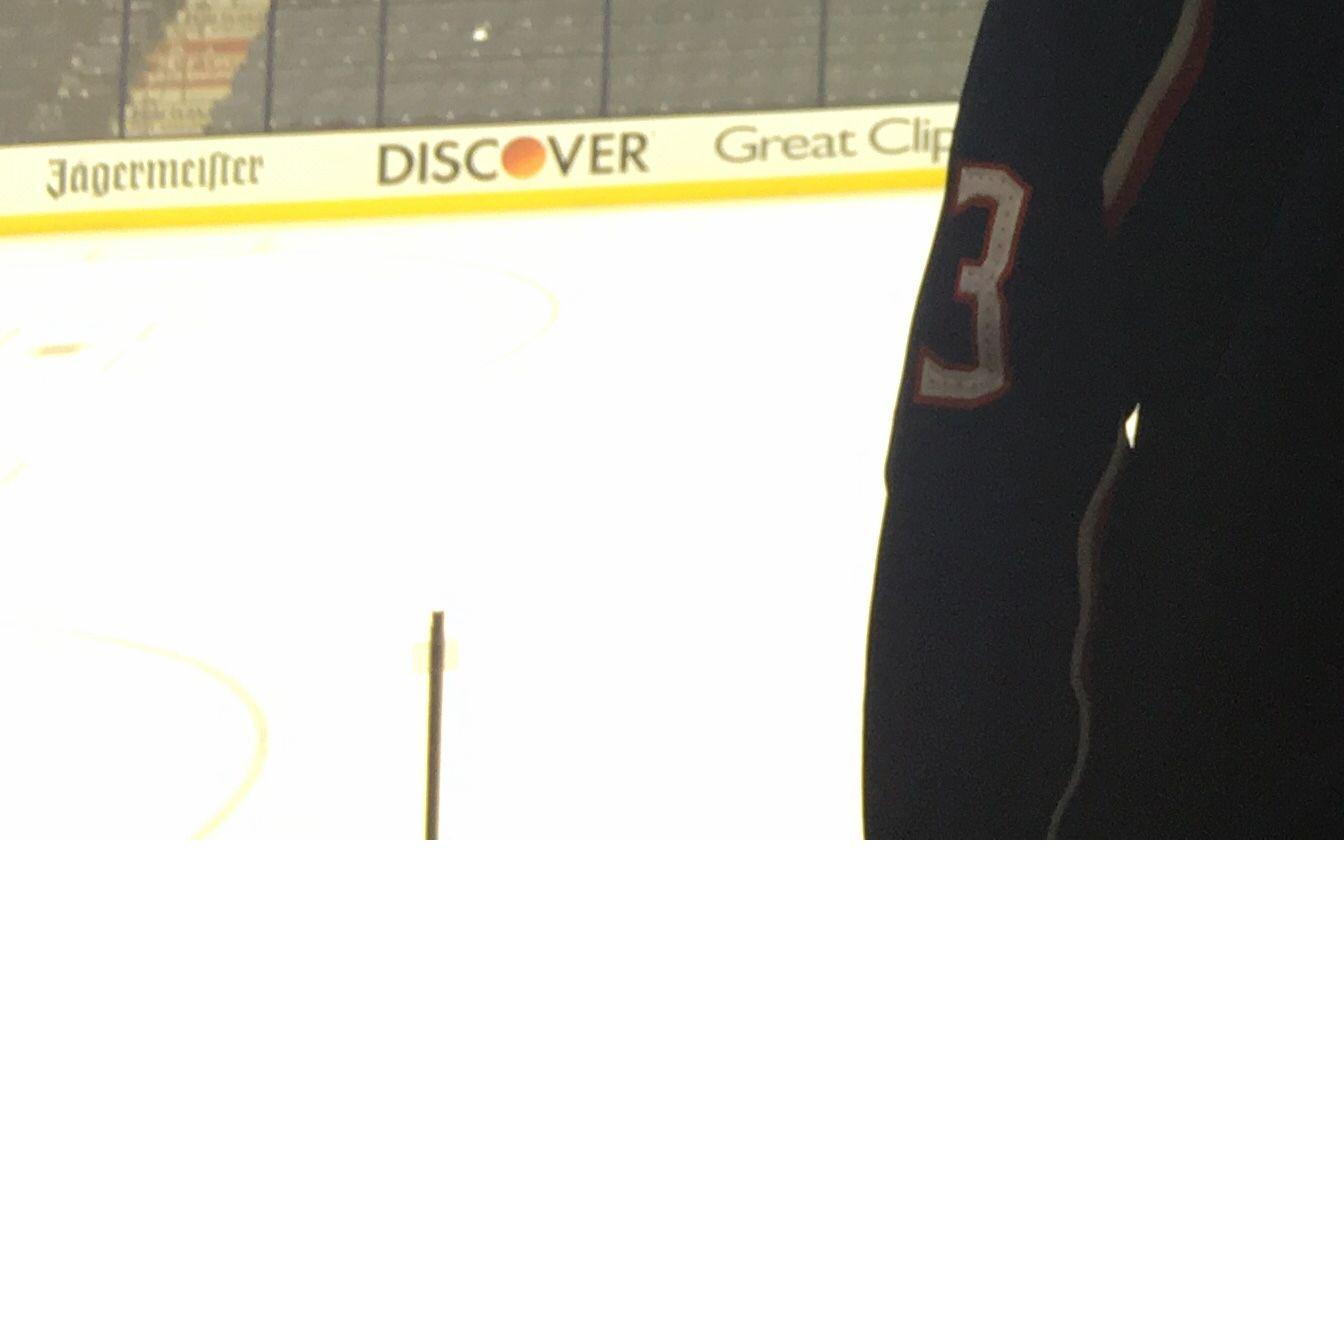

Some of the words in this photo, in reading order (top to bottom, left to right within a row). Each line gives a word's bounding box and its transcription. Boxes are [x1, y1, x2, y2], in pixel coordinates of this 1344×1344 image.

[378, 130, 650, 187] DISCOVER
[713, 125, 858, 164] Great
[913, 160, 1034, 409] 3
